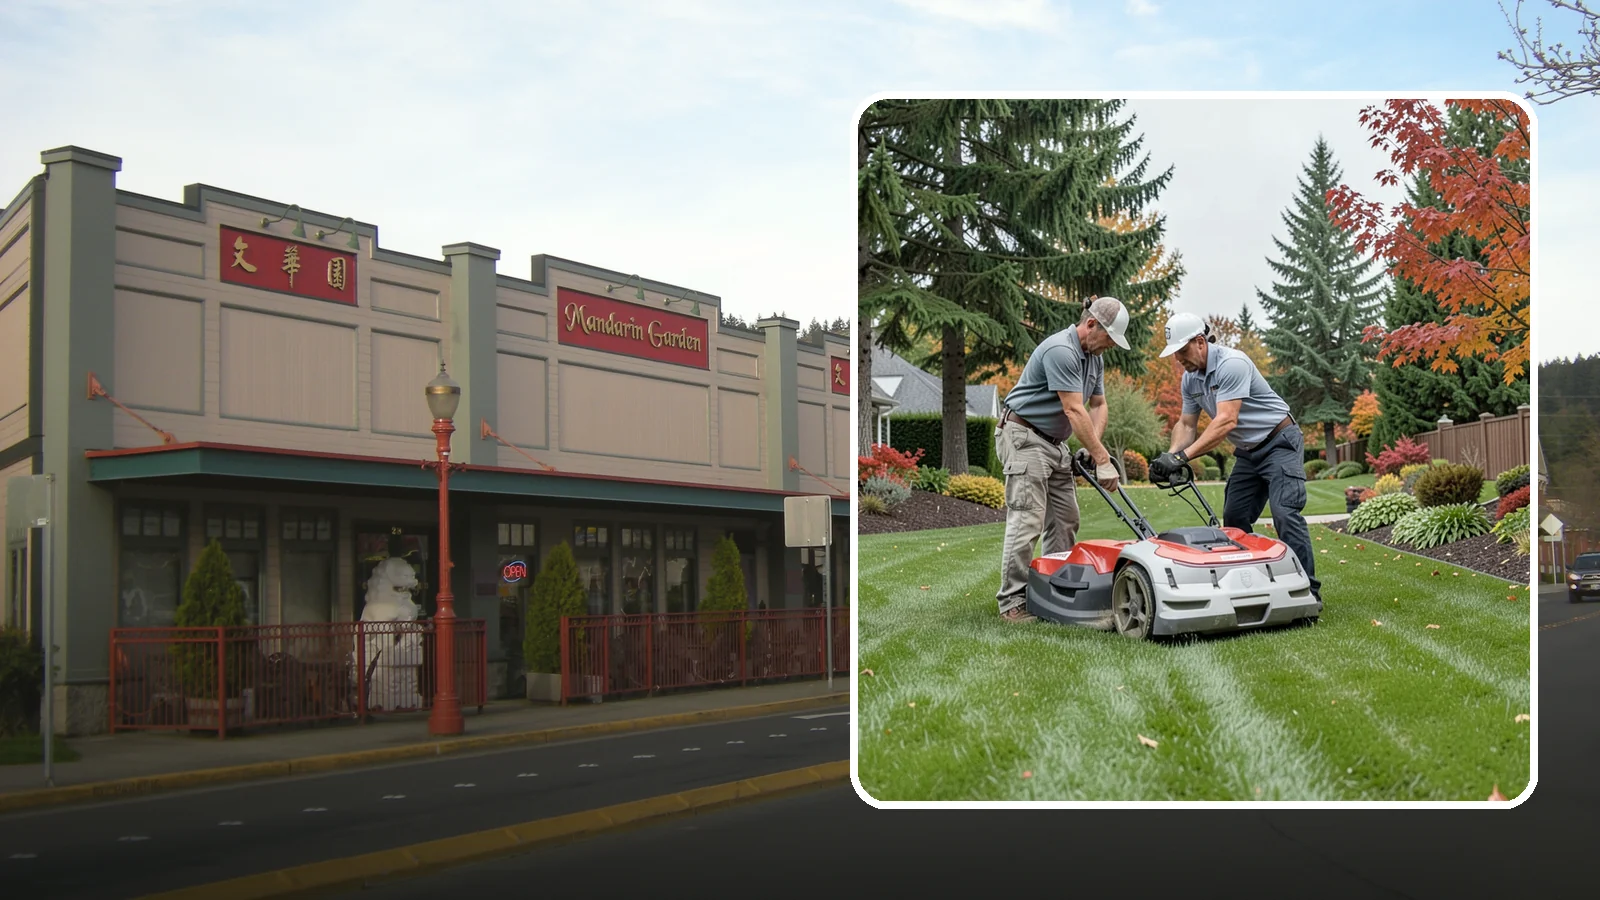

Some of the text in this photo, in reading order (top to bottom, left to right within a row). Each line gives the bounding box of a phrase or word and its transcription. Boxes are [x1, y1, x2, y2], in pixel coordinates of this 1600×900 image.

[232, 237, 346, 290] 文華園
[565, 302, 701, 352] Mandarin Garden
[503, 565, 527, 578] OPEN
